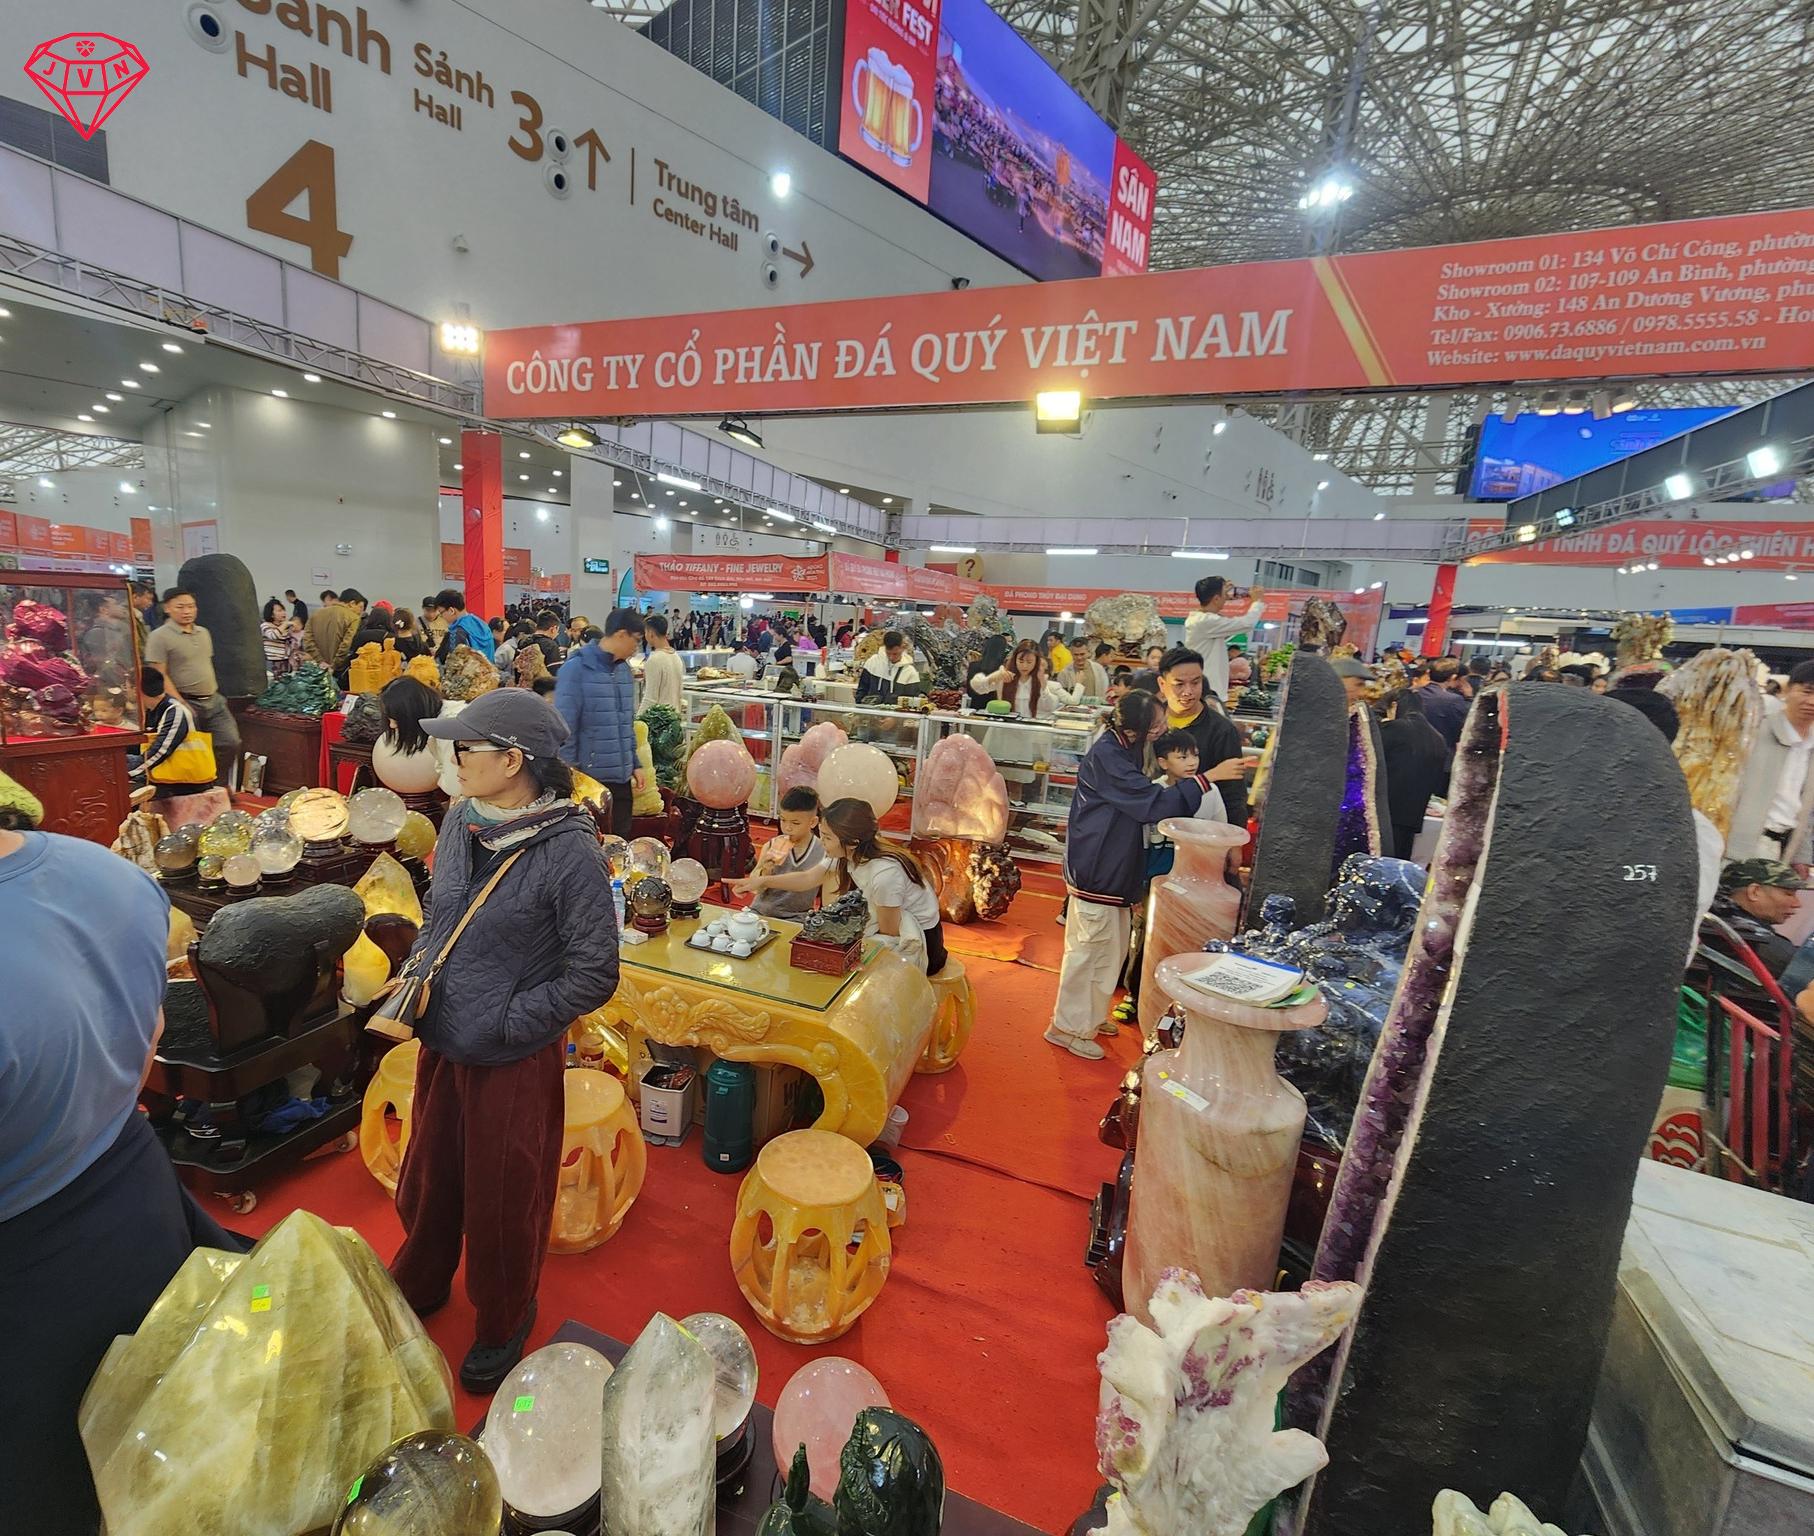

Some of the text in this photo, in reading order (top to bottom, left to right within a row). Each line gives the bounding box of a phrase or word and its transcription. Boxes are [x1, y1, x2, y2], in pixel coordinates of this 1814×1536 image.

[902, 2, 933, 45] FEST
[235, 30, 332, 113] Hall
[414, 42, 544, 162] Sảnh 3
[414, 88, 462, 131] Hall
[246, 139, 354, 280] 4
[654, 158, 759, 232] Trung tâm
[653, 198, 738, 252] Center Hall
[1110, 210, 1146, 268] NAM
[1441, 262, 1534, 279] Showroom
[1538, 255, 1566, 270] 01:
[1572, 250, 1605, 268] 134
[1610, 247, 1637, 265] Võ
[1642, 242, 1680, 261] Chí
[1683, 239, 1743, 258] Công,
[1437, 284, 1530, 301] Showroom
[1535, 277, 1562, 292] 02:
[1568, 269, 1640, 291] 107-109
[1643, 267, 1672, 284] An
[1678, 262, 1733, 282] Bình,
[1432, 306, 1470, 322] Kho
[1556, 296, 1588, 313] 148
[1591, 294, 1620, 310] An
[1624, 290, 1694, 308] Dương
[1699, 285, 1771, 304] Vương,
[1430, 327, 1498, 345] Tel/Fax:
[1503, 318, 1618, 341] 0906.73.6886
[1632, 309, 1760, 333] 0978.5555.58
[506, 308, 1293, 395] CÔNG TY CỔ PHẦN ĐÁ QUÝ VIỆT NAM
[1426, 336, 1766, 366] Website: www.daquyvietnam.com.vn
[1607, 528, 1636, 554] ĐÁ
[1642, 529, 1687, 554] QUÝ
[1622, 864, 1658, 881] 257
